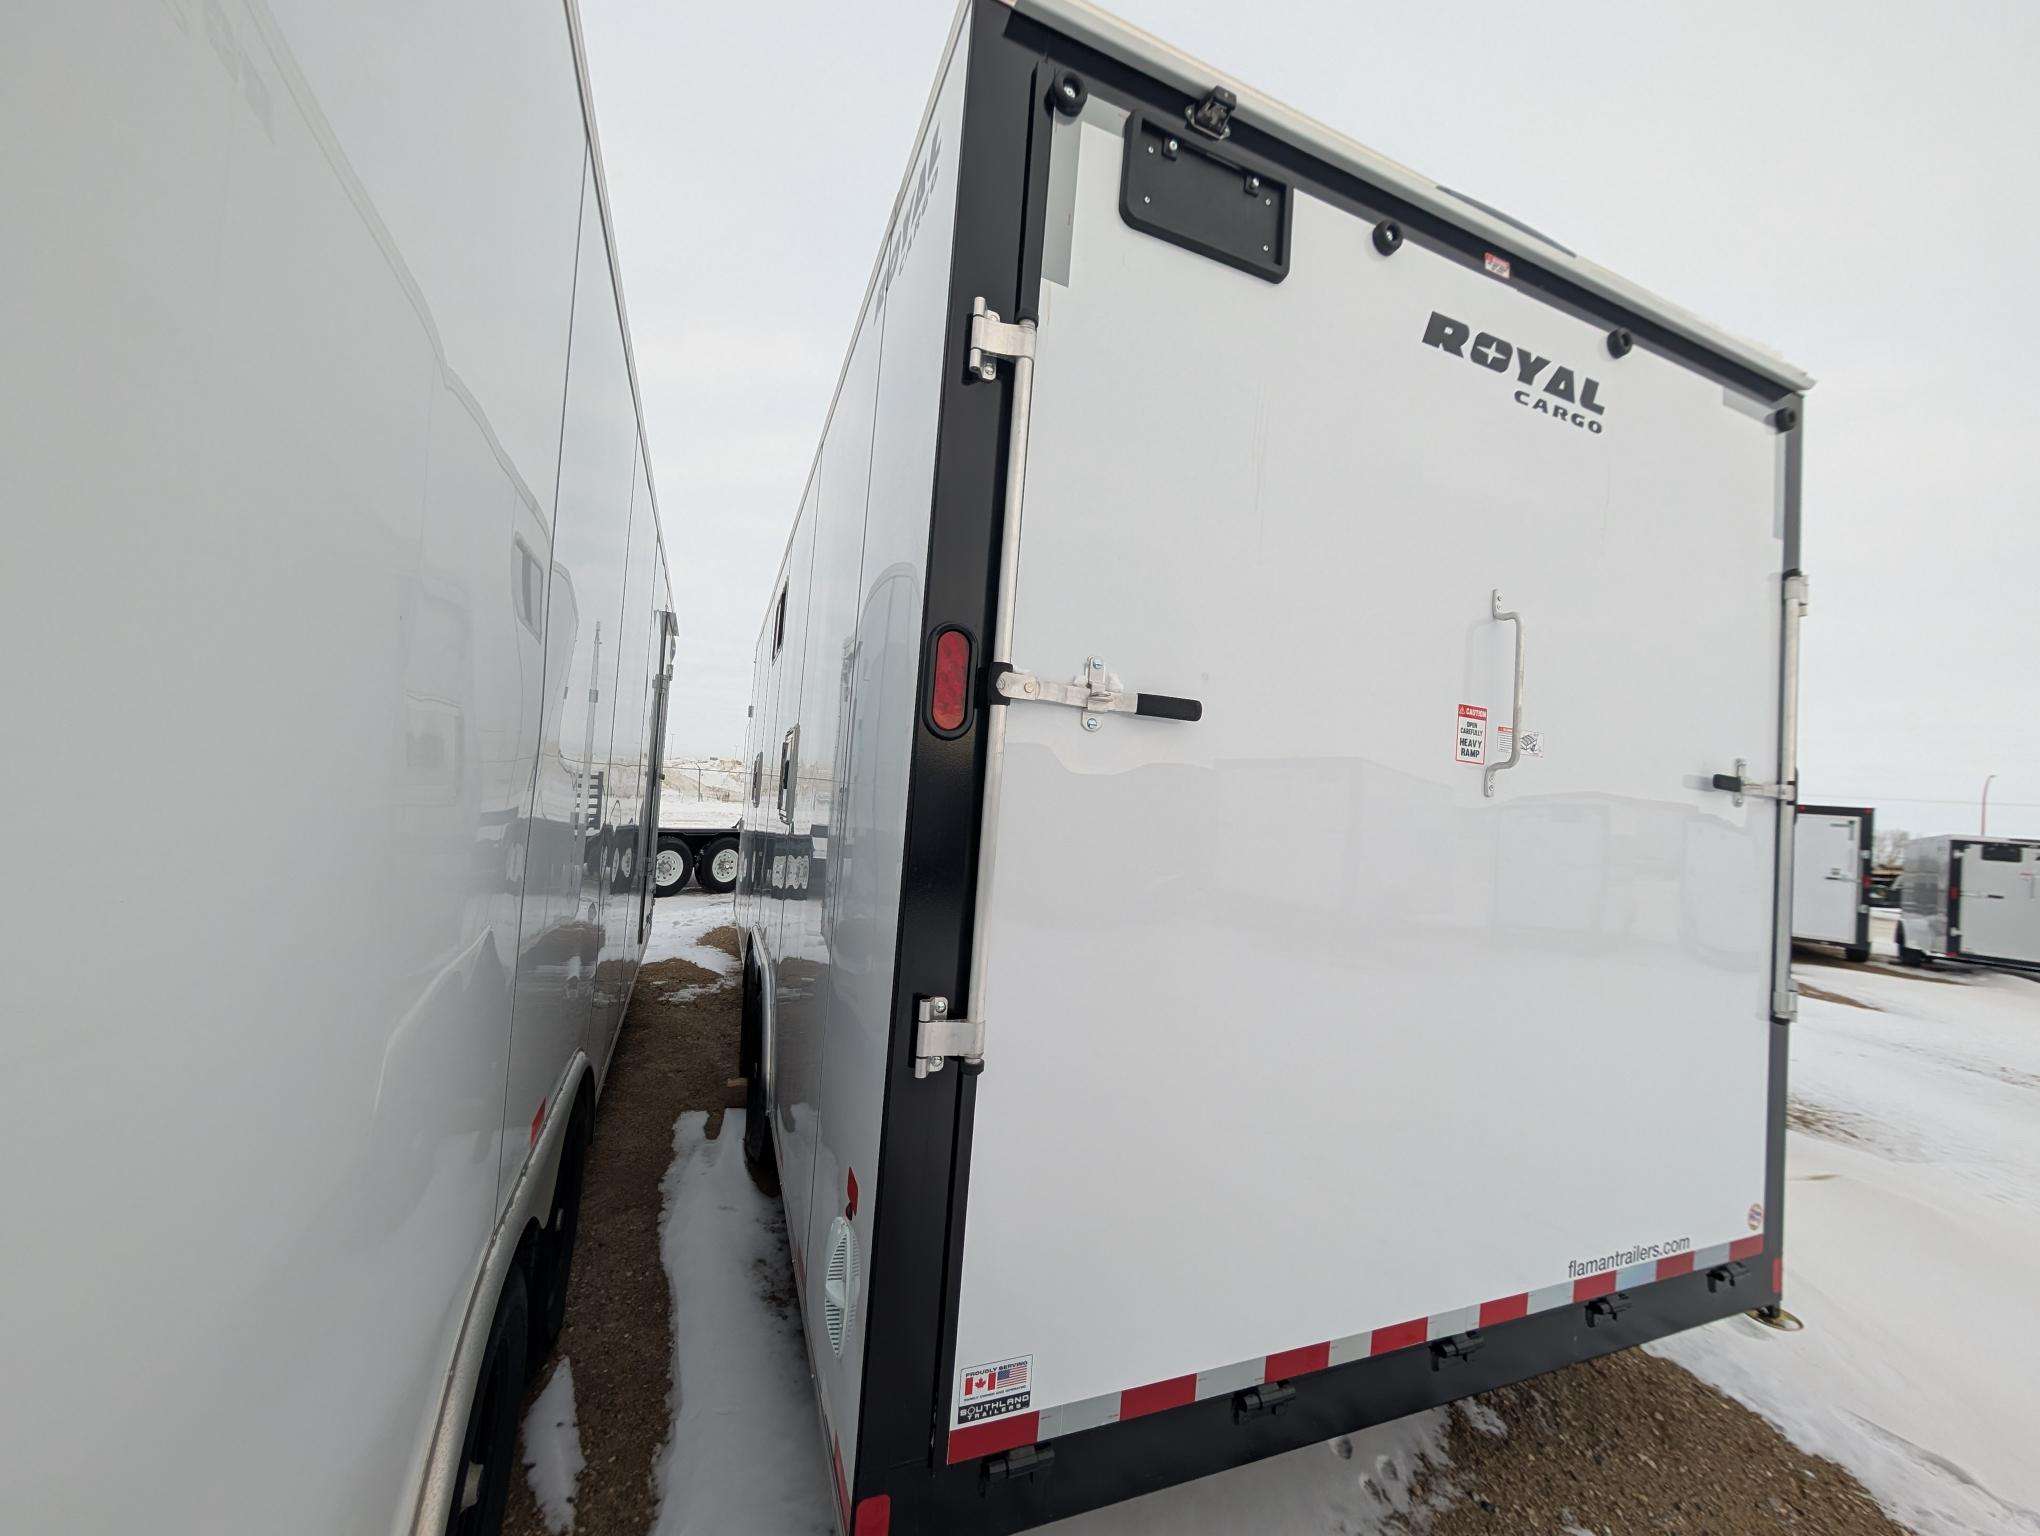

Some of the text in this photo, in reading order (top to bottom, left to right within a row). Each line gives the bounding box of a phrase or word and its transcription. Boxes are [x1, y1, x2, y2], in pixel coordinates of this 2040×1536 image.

[1422, 311, 1605, 415] ROYAL
[1514, 390, 1603, 434] CARGO
[1460, 727, 1483, 737] CAREFULLY
[1459, 738, 1482, 748] HEAVY
[1460, 748, 1480, 758] RAMP
[1568, 1237, 1690, 1279] flamantrailers.com
[965, 1360, 1028, 1377] PROUDLY SERVING
[960, 1394, 1030, 1416] SOUTHLAND
[967, 1403, 1021, 1420] TRAILERS
